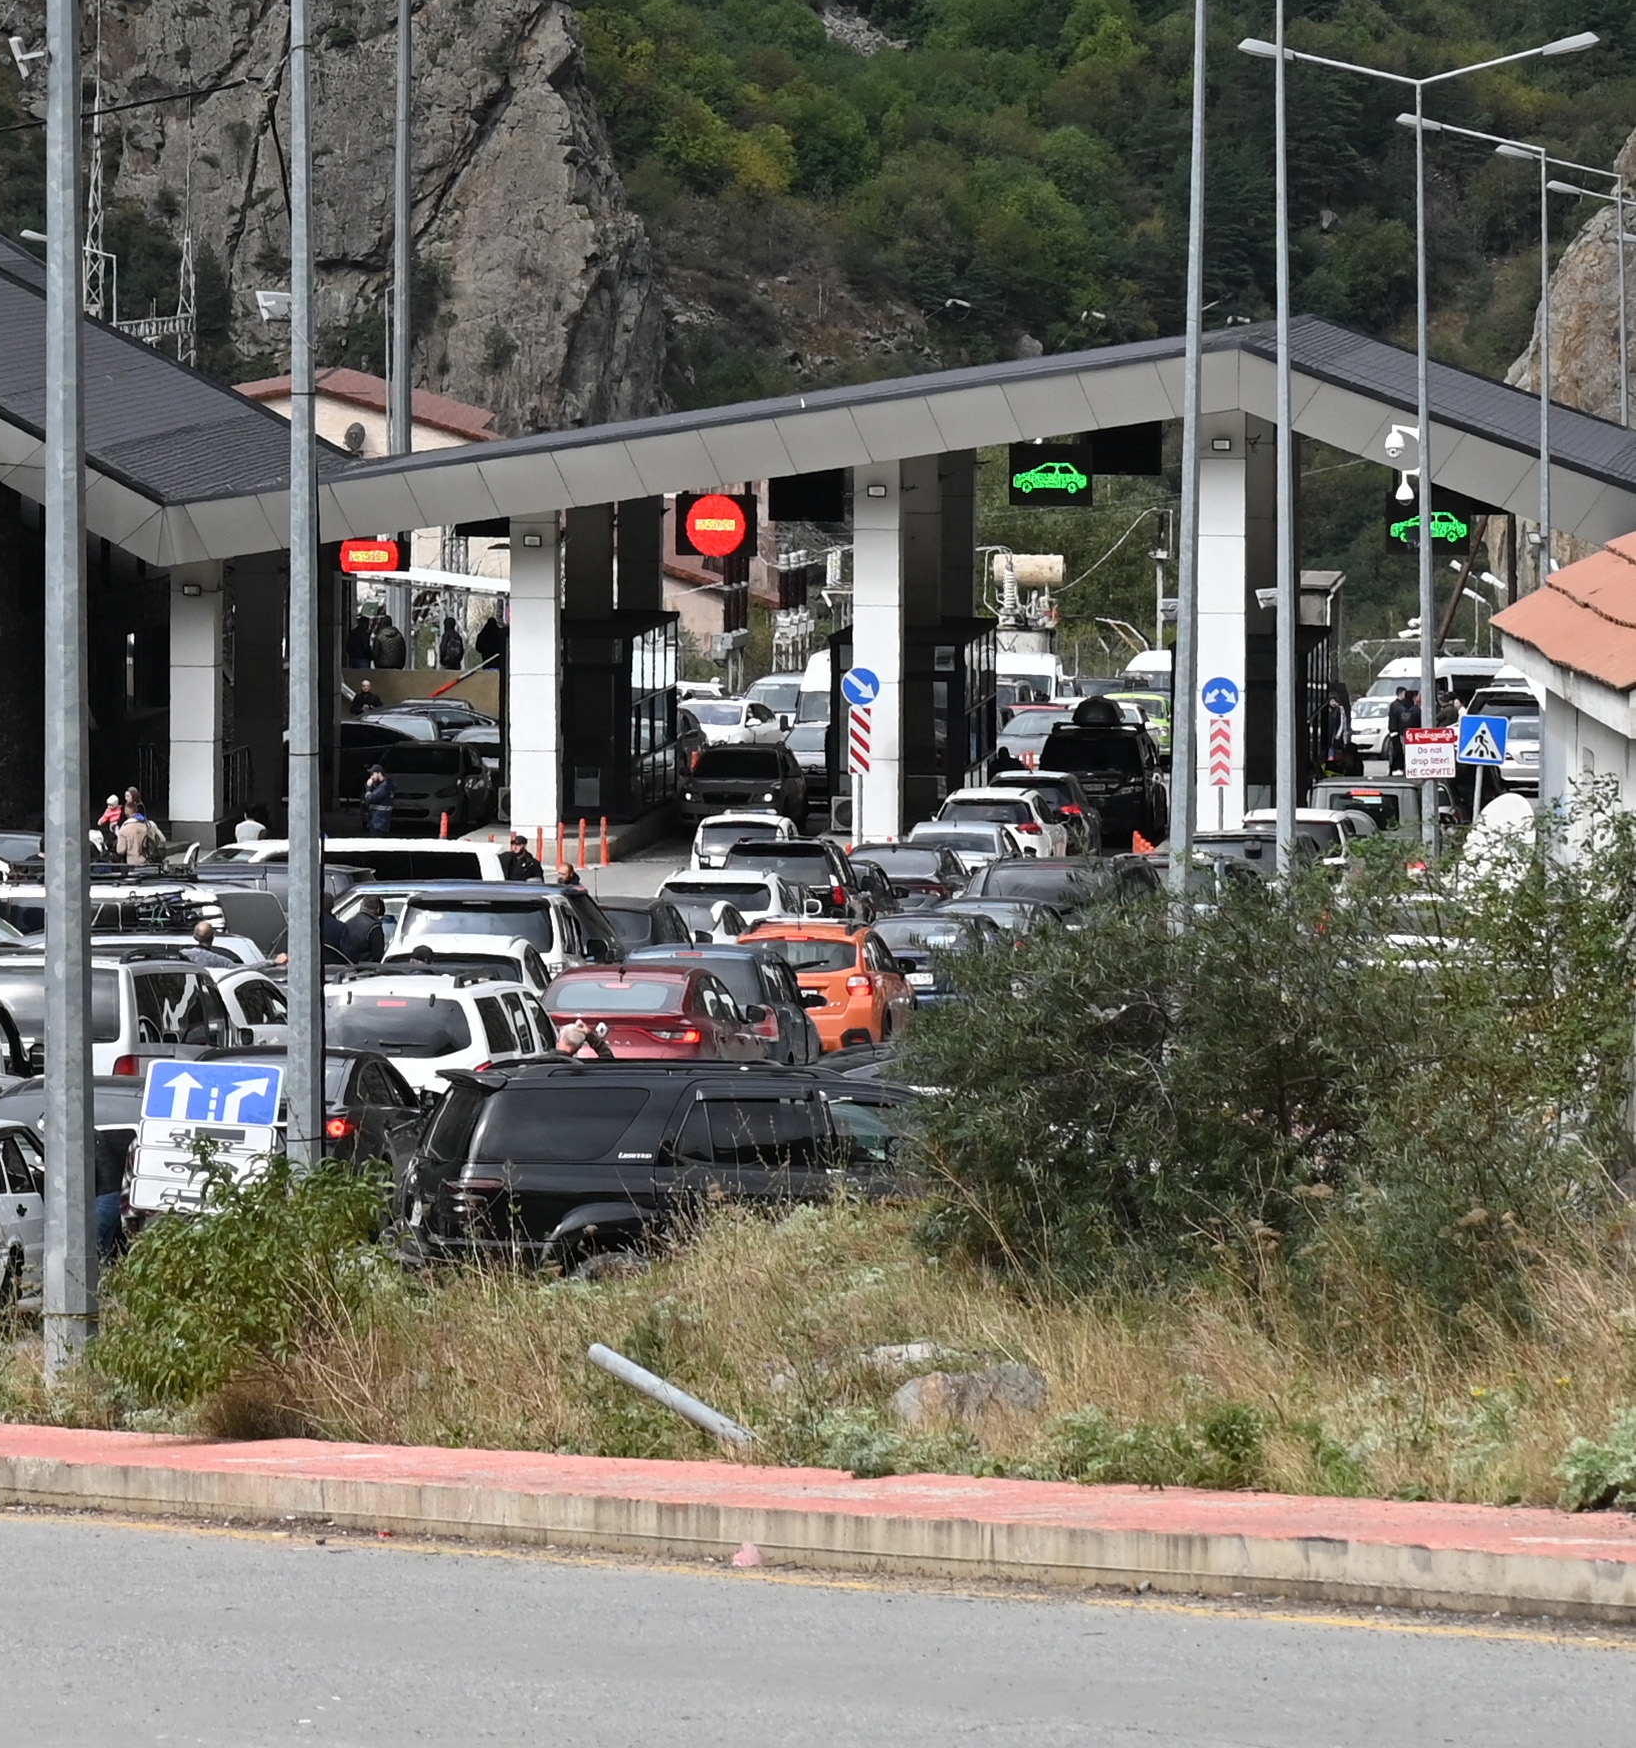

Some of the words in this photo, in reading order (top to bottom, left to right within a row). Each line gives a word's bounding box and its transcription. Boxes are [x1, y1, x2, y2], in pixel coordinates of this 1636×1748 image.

[1411, 757, 1429, 766] drop
[1407, 768, 1417, 776] НЕ
[1420, 767, 1454, 776] СОРИТЕ!
